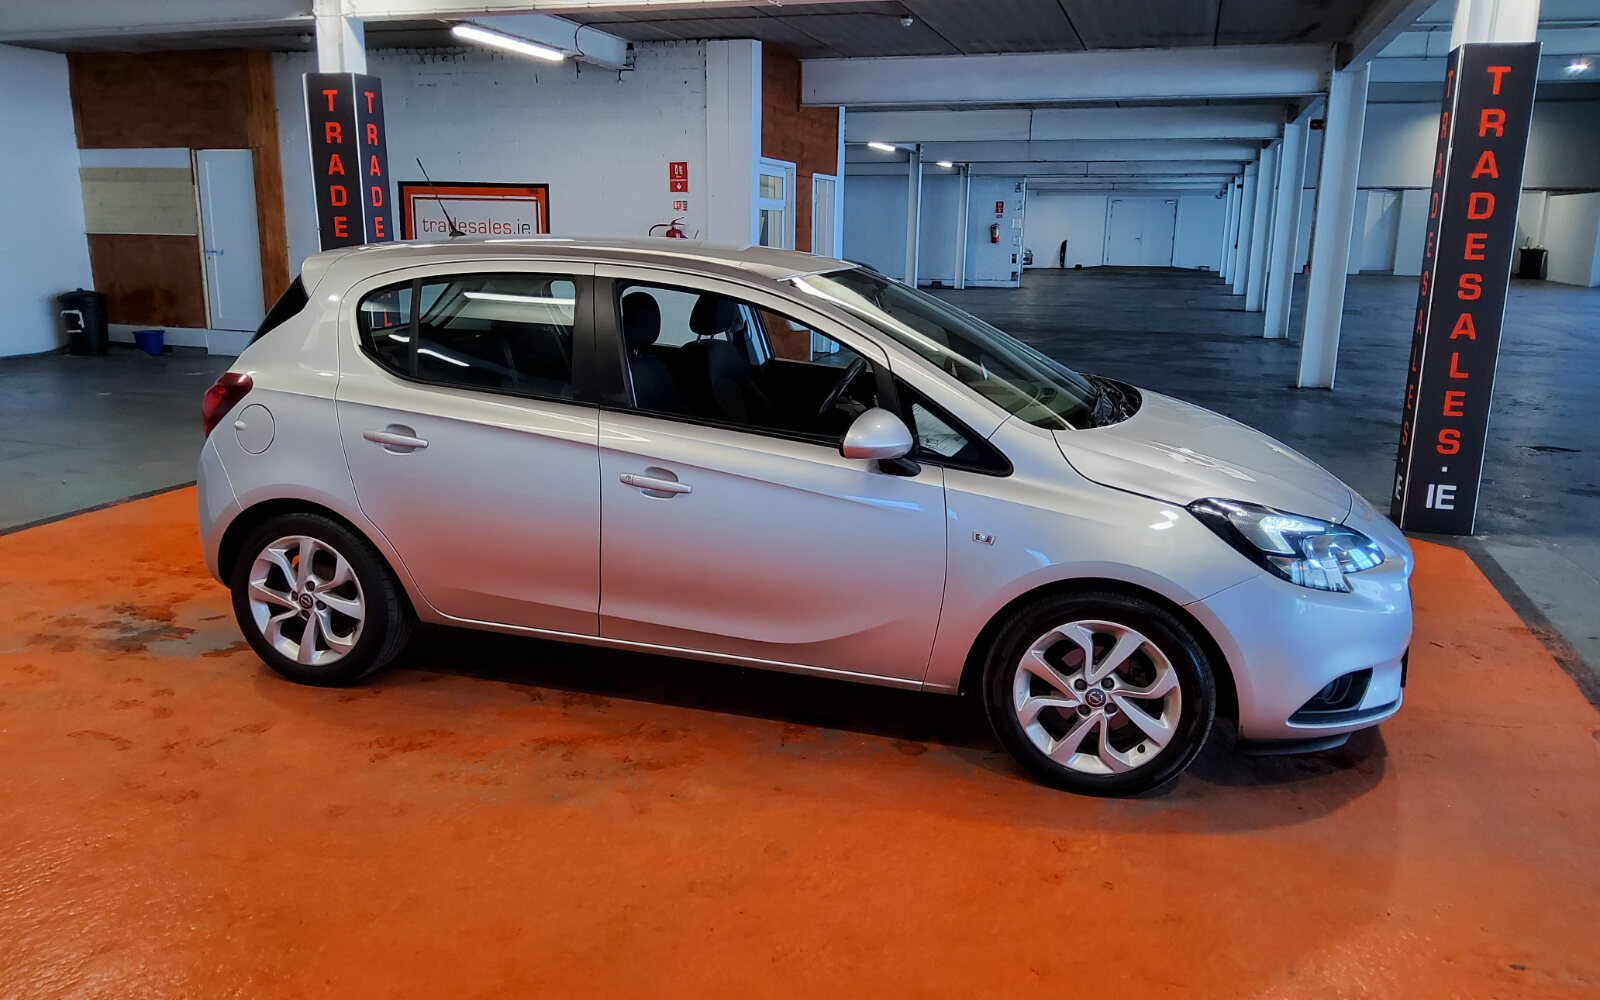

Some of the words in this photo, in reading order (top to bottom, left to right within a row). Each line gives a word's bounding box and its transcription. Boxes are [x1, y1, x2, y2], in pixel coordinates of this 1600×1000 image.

[322, 89, 349, 238] TRADE
[364, 91, 385, 238] TRADE
[422, 217, 531, 235] tradesales.ie
